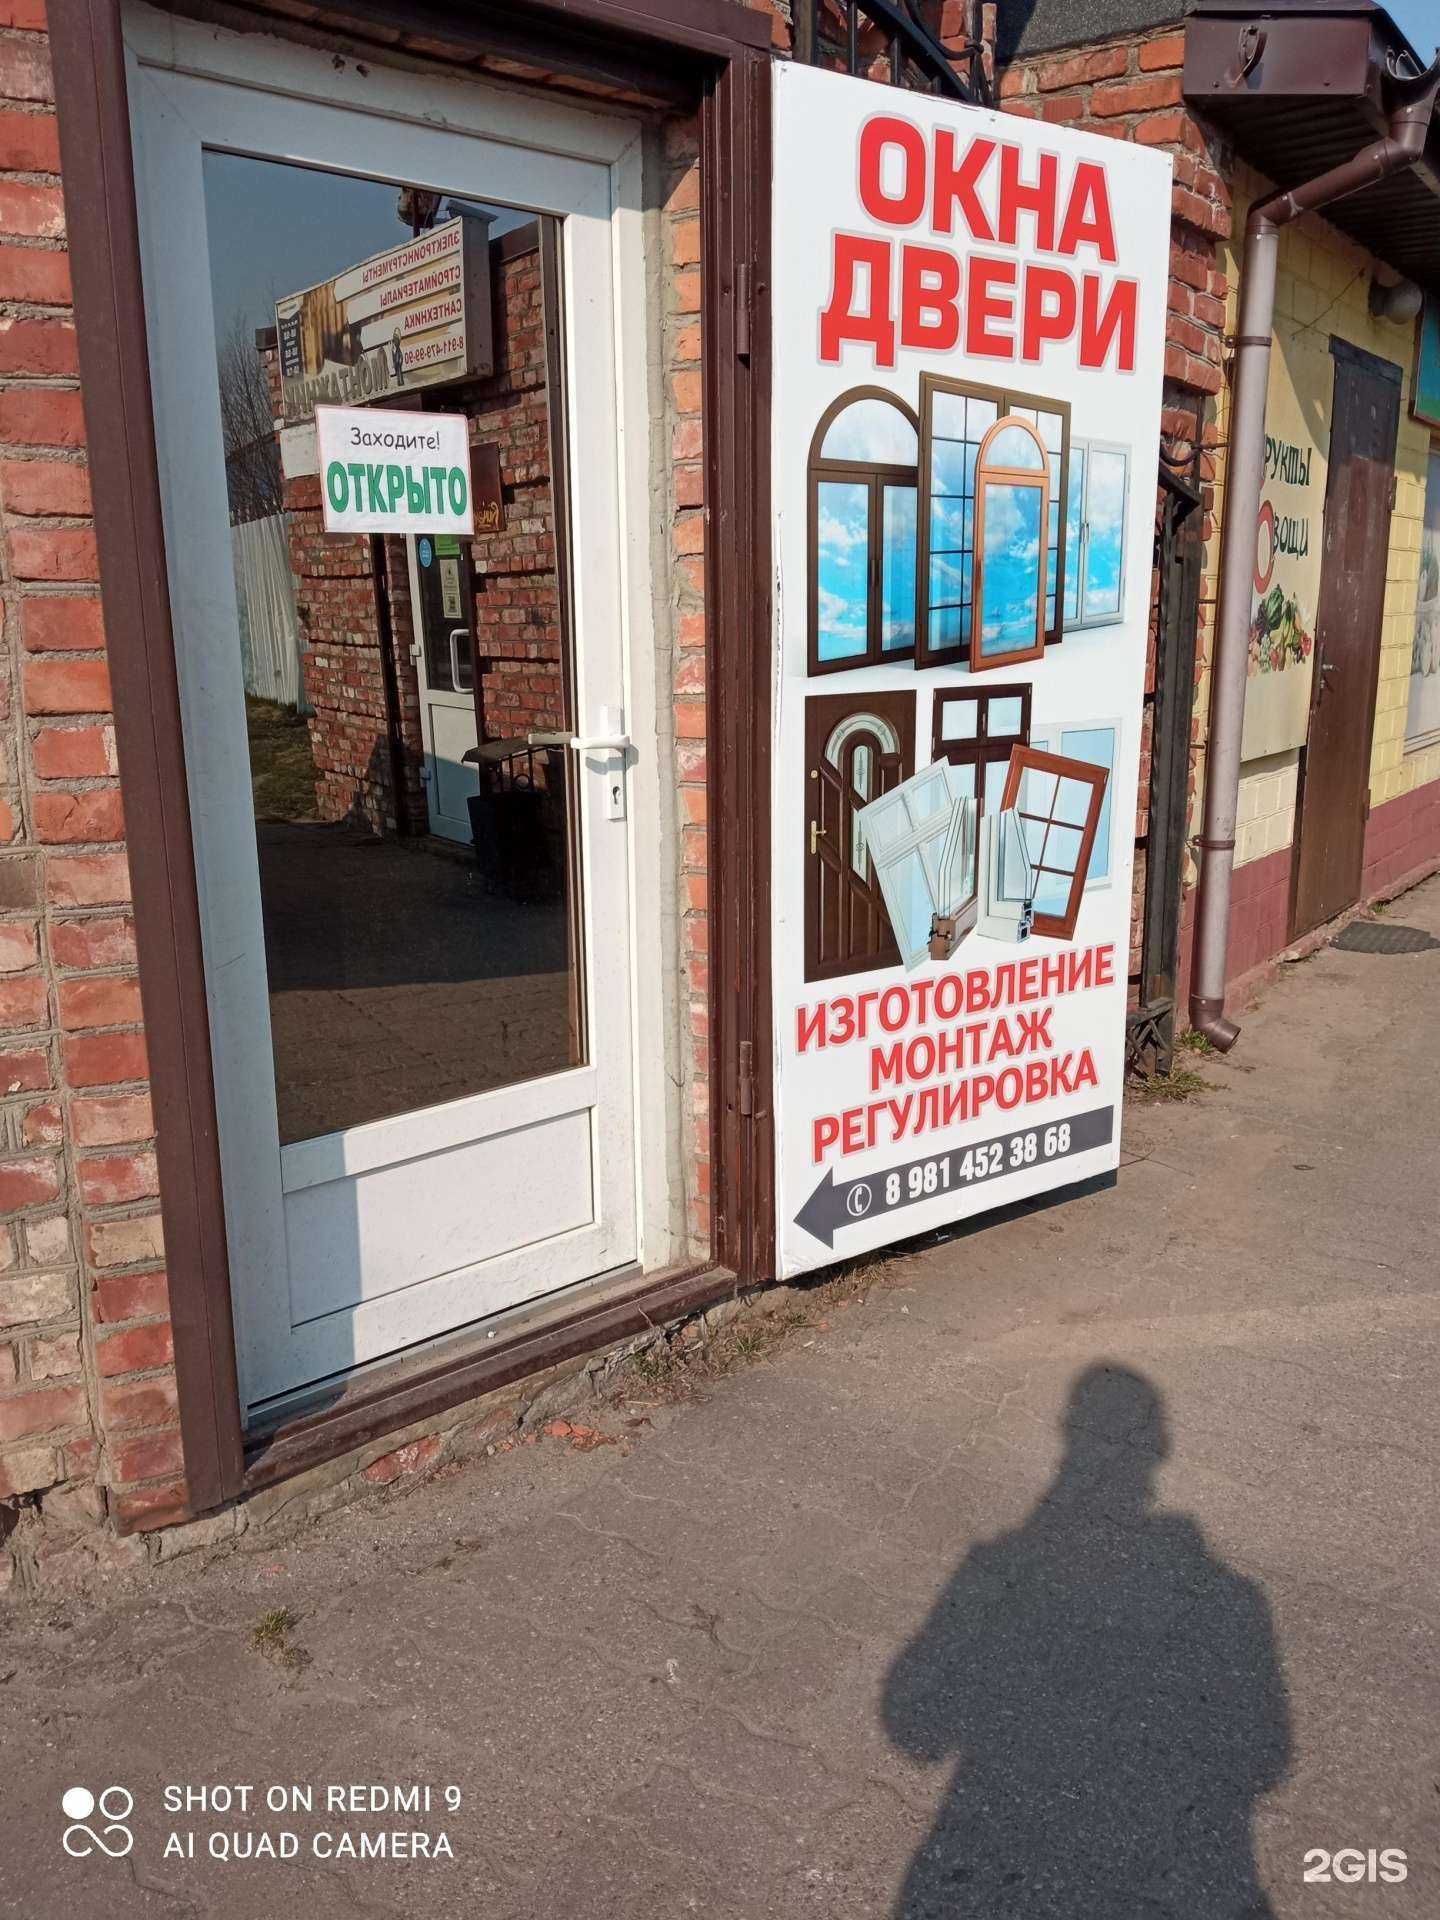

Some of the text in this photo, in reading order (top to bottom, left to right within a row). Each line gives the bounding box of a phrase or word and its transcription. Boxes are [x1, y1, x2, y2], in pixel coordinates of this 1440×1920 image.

[858, 113, 1119, 264] ОКНА
[819, 231, 1139, 371] ДВЕРИ
[351, 427, 440, 450] Заходите!
[1260, 434, 1312, 487] рукты
[327, 461, 467, 516] ОТКРЫТО
[796, 943, 1115, 1054] ИЗГОТОВЛЕНИЕ
[868, 1006, 1054, 1092] МОНТАЖ
[812, 1047, 1099, 1164] РЕГУЛИРОВКА
[885, 1123, 1071, 1205] 8 981 452 38 68
